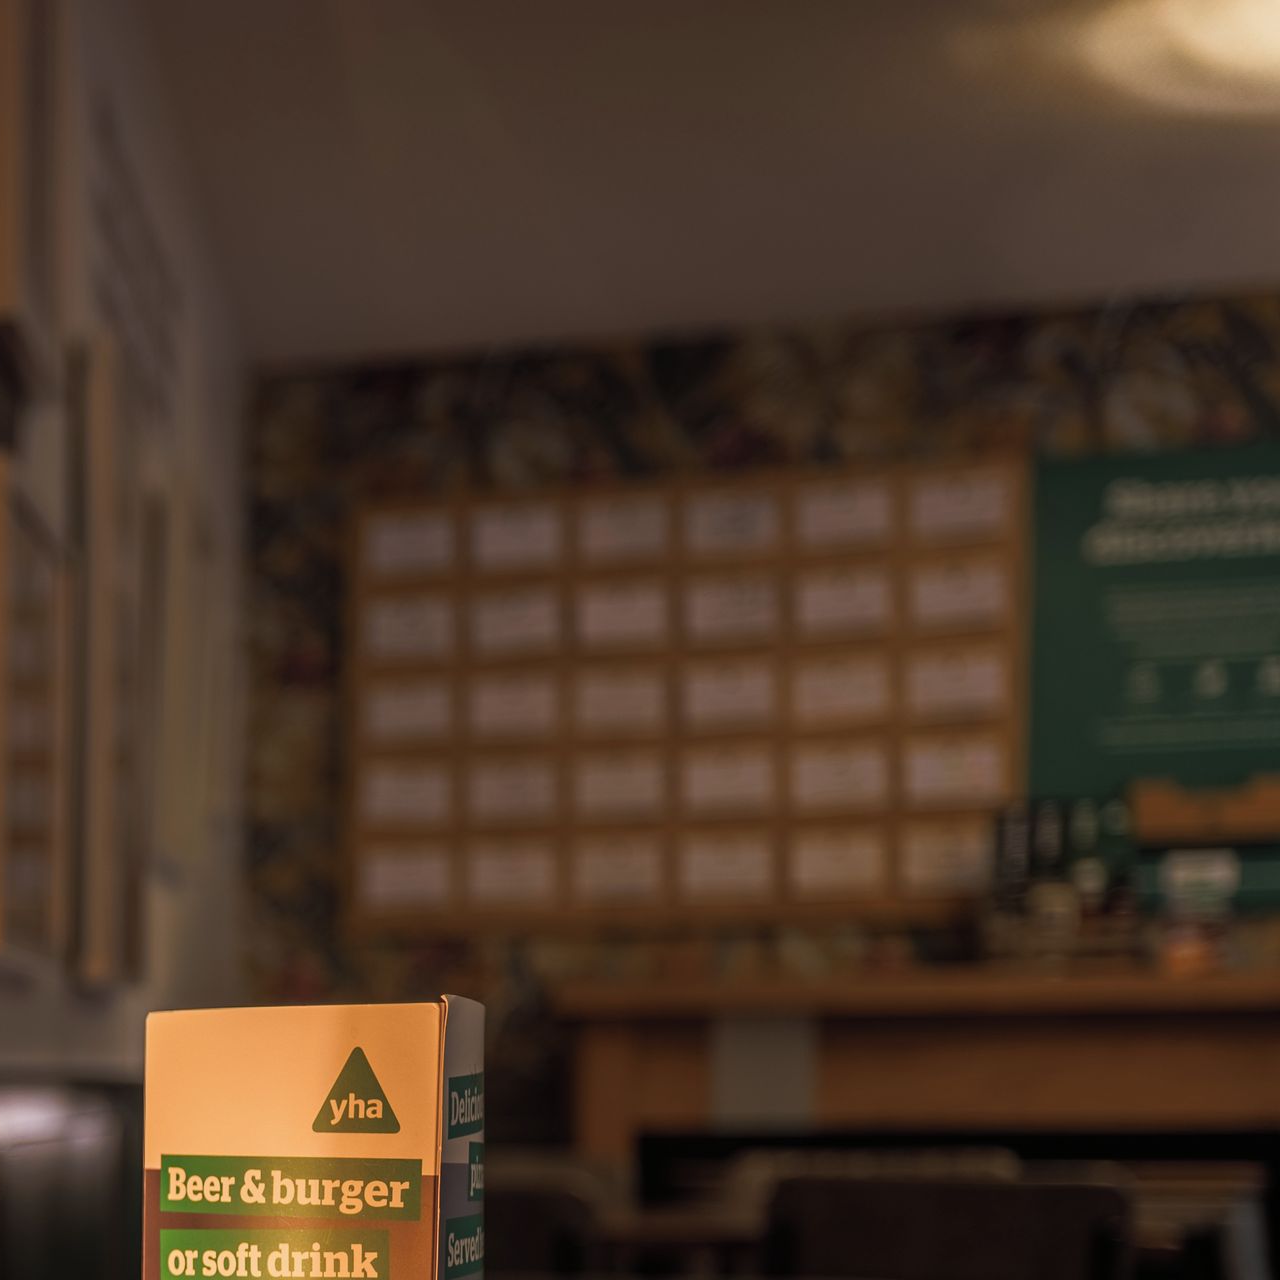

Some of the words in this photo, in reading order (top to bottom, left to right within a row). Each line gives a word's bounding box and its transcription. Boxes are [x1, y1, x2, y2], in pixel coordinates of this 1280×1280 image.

[329, 1093, 383, 1126] yha
[168, 1167, 235, 1203] Beer
[240, 1169, 266, 1204] &
[271, 1170, 410, 1214] burger
[168, 1249, 198, 1276] or
[202, 1242, 261, 1277] soft
[267, 1242, 378, 1279] drink
